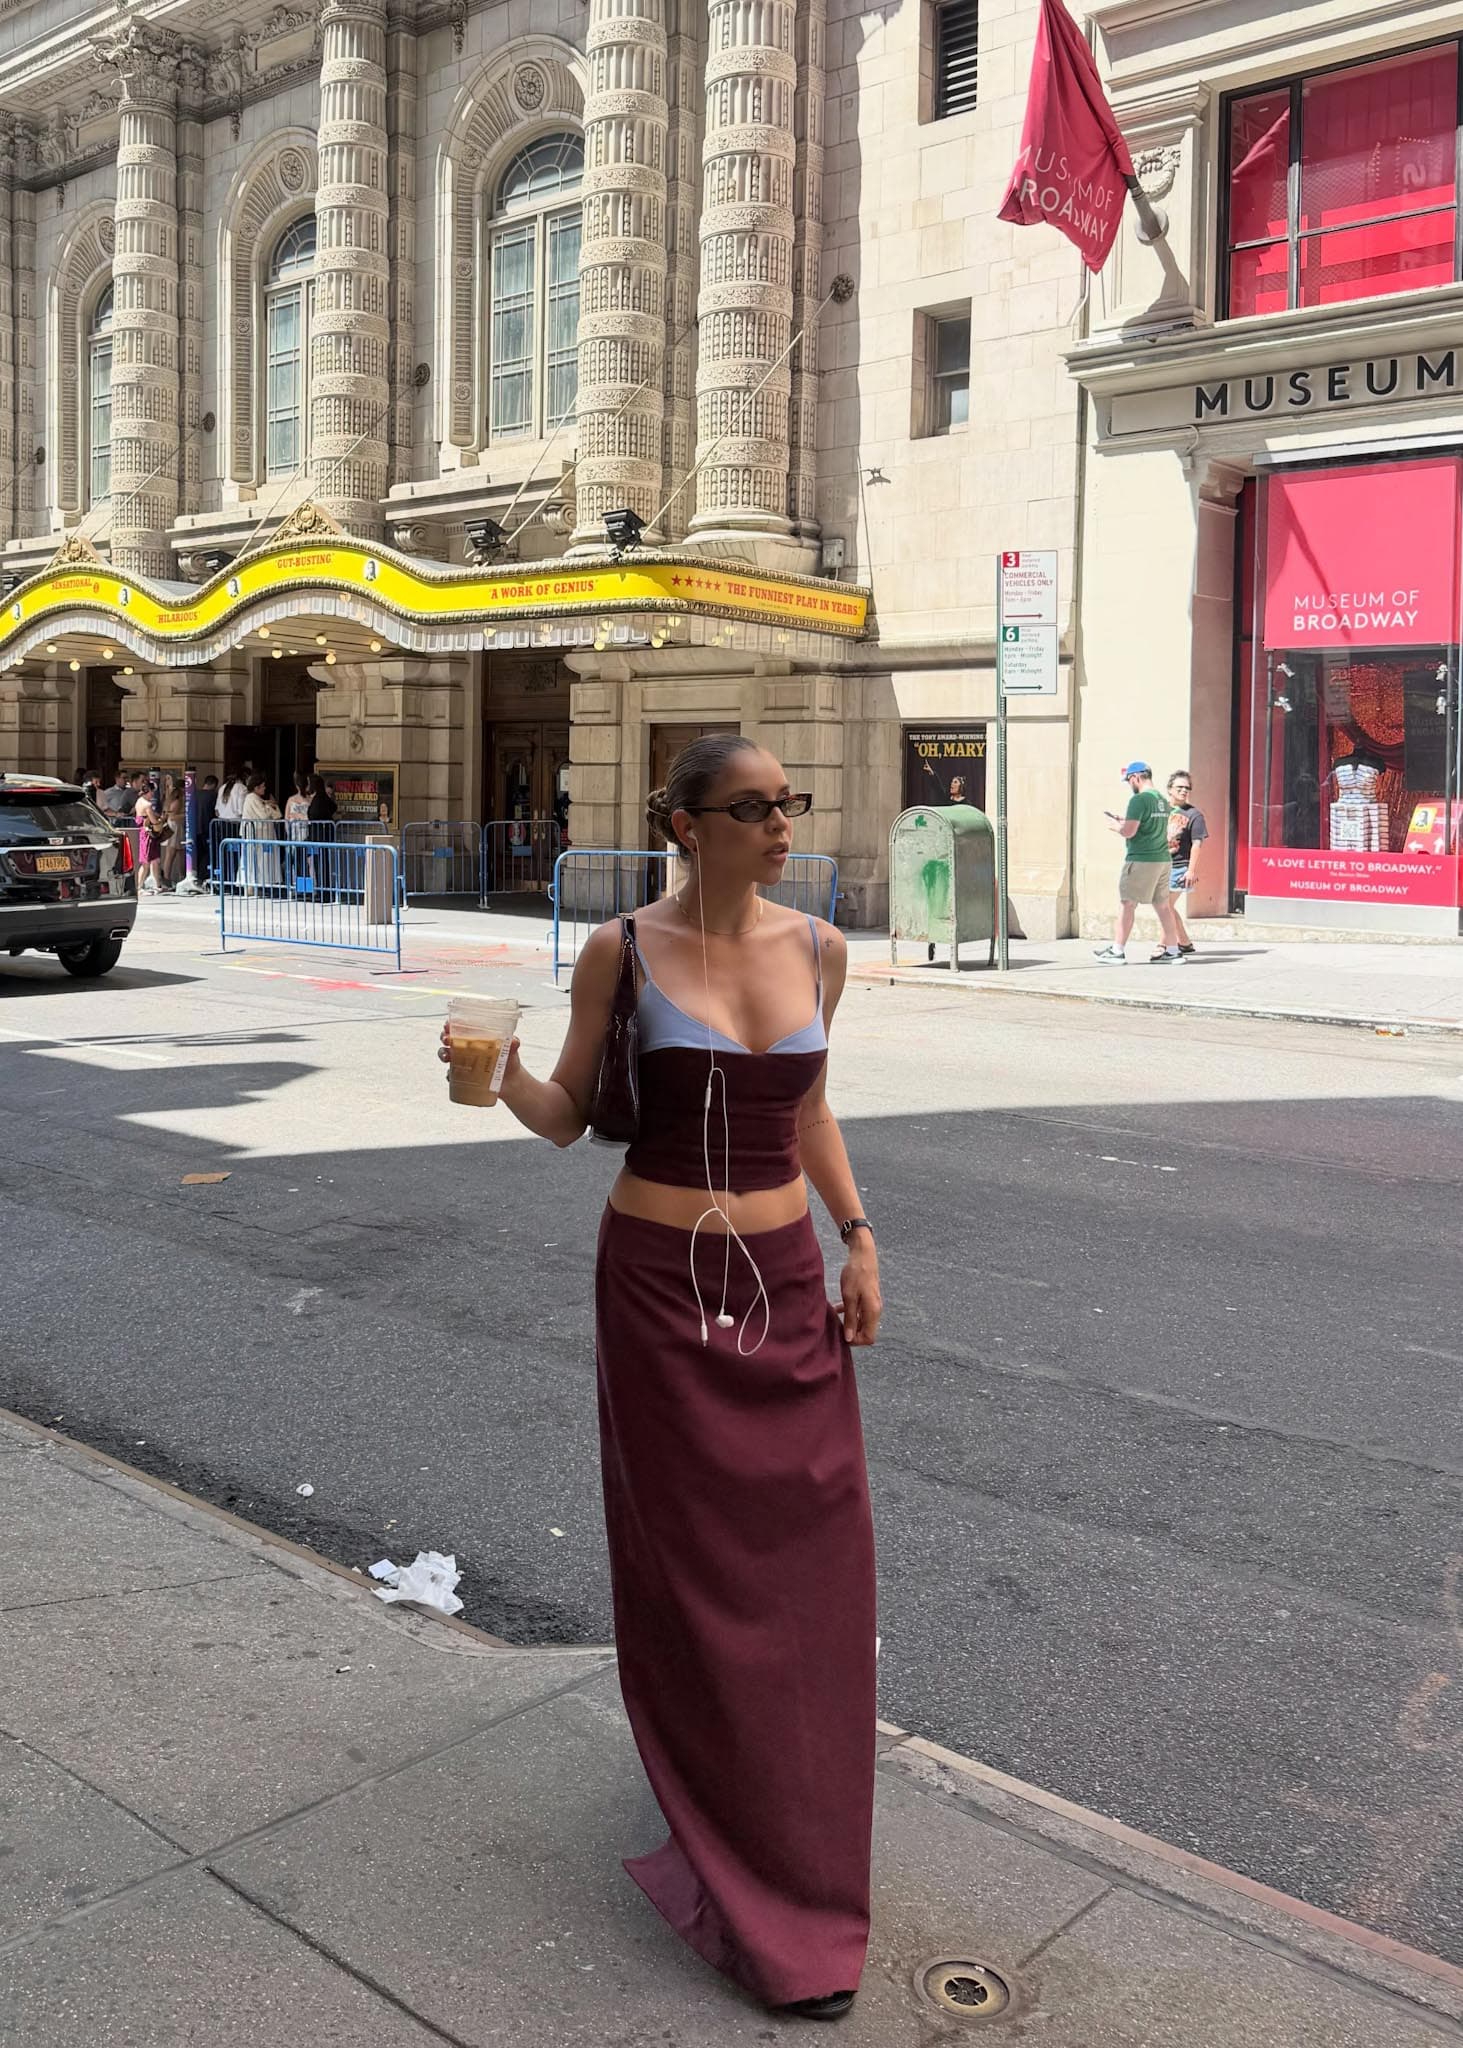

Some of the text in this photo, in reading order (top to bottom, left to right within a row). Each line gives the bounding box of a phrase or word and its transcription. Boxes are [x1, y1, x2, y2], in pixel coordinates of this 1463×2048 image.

[1095, 186, 1115, 211] OF
[1195, 351, 1455, 419] MUSEUM
[1006, 552, 1016, 567] 3
[1005, 571, 1046, 579] COMMERCIAL
[501, 585, 533, 598] WORK
[536, 583, 551, 596] OF
[749, 586, 794, 605] FUNNIEST
[796, 595, 818, 609] PLAY
[820, 599, 831, 610] IN
[1294, 590, 1420, 611] MUSEUM OF
[1293, 610, 1418, 631] BROADWAY
[1006, 627, 1016, 641] 6
[943, 743, 986, 758] MARY
[1277, 858, 1305, 869] LOVE
[1308, 860, 1347, 871] LETTER
[1349, 861, 1365, 871] TO
[1290, 880, 1409, 895] MUSEUM OF BROADWAY
